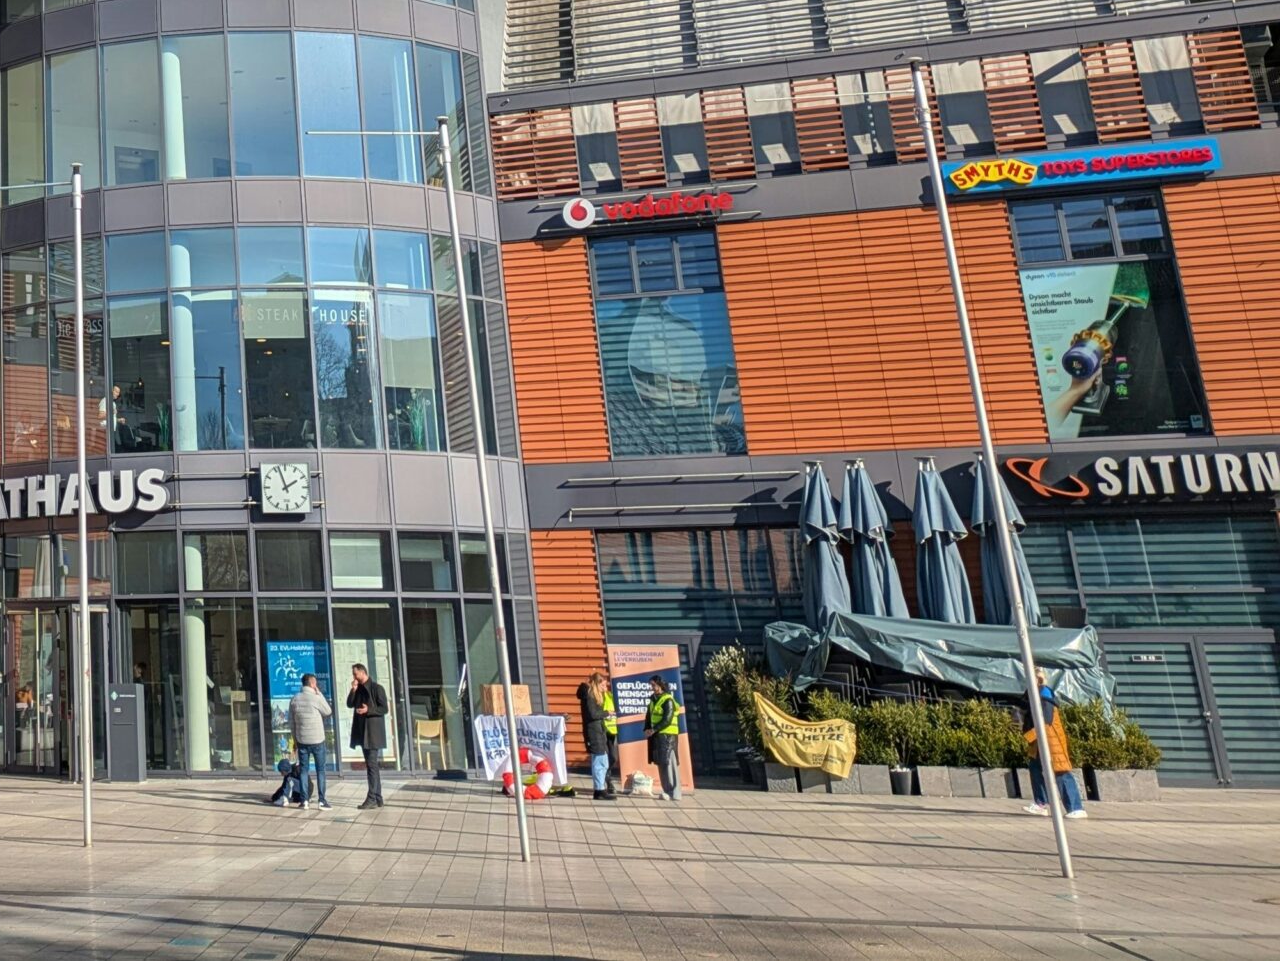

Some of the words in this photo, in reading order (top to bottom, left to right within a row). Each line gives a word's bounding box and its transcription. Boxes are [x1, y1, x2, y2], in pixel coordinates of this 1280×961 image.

[952, 161, 1035, 187] SMYTHS
[1042, 158, 1087, 177] TOYS
[1090, 147, 1214, 171] SUPERSTORES
[602, 192, 734, 220] vodafone
[1028, 292, 1049, 301] Dyson
[1051, 291, 1071, 299] macht
[1030, 299, 1072, 308] unsichtbaren
[1074, 297, 1094, 305] Staub
[256, 307, 299, 321] STEAK
[319, 308, 366, 323] HOUSE
[1031, 307, 1058, 315] sichtbar
[1094, 451, 1280, 497] SATURN
[618, 698, 644, 706] IHREM
[802, 733, 844, 742] HETZE
